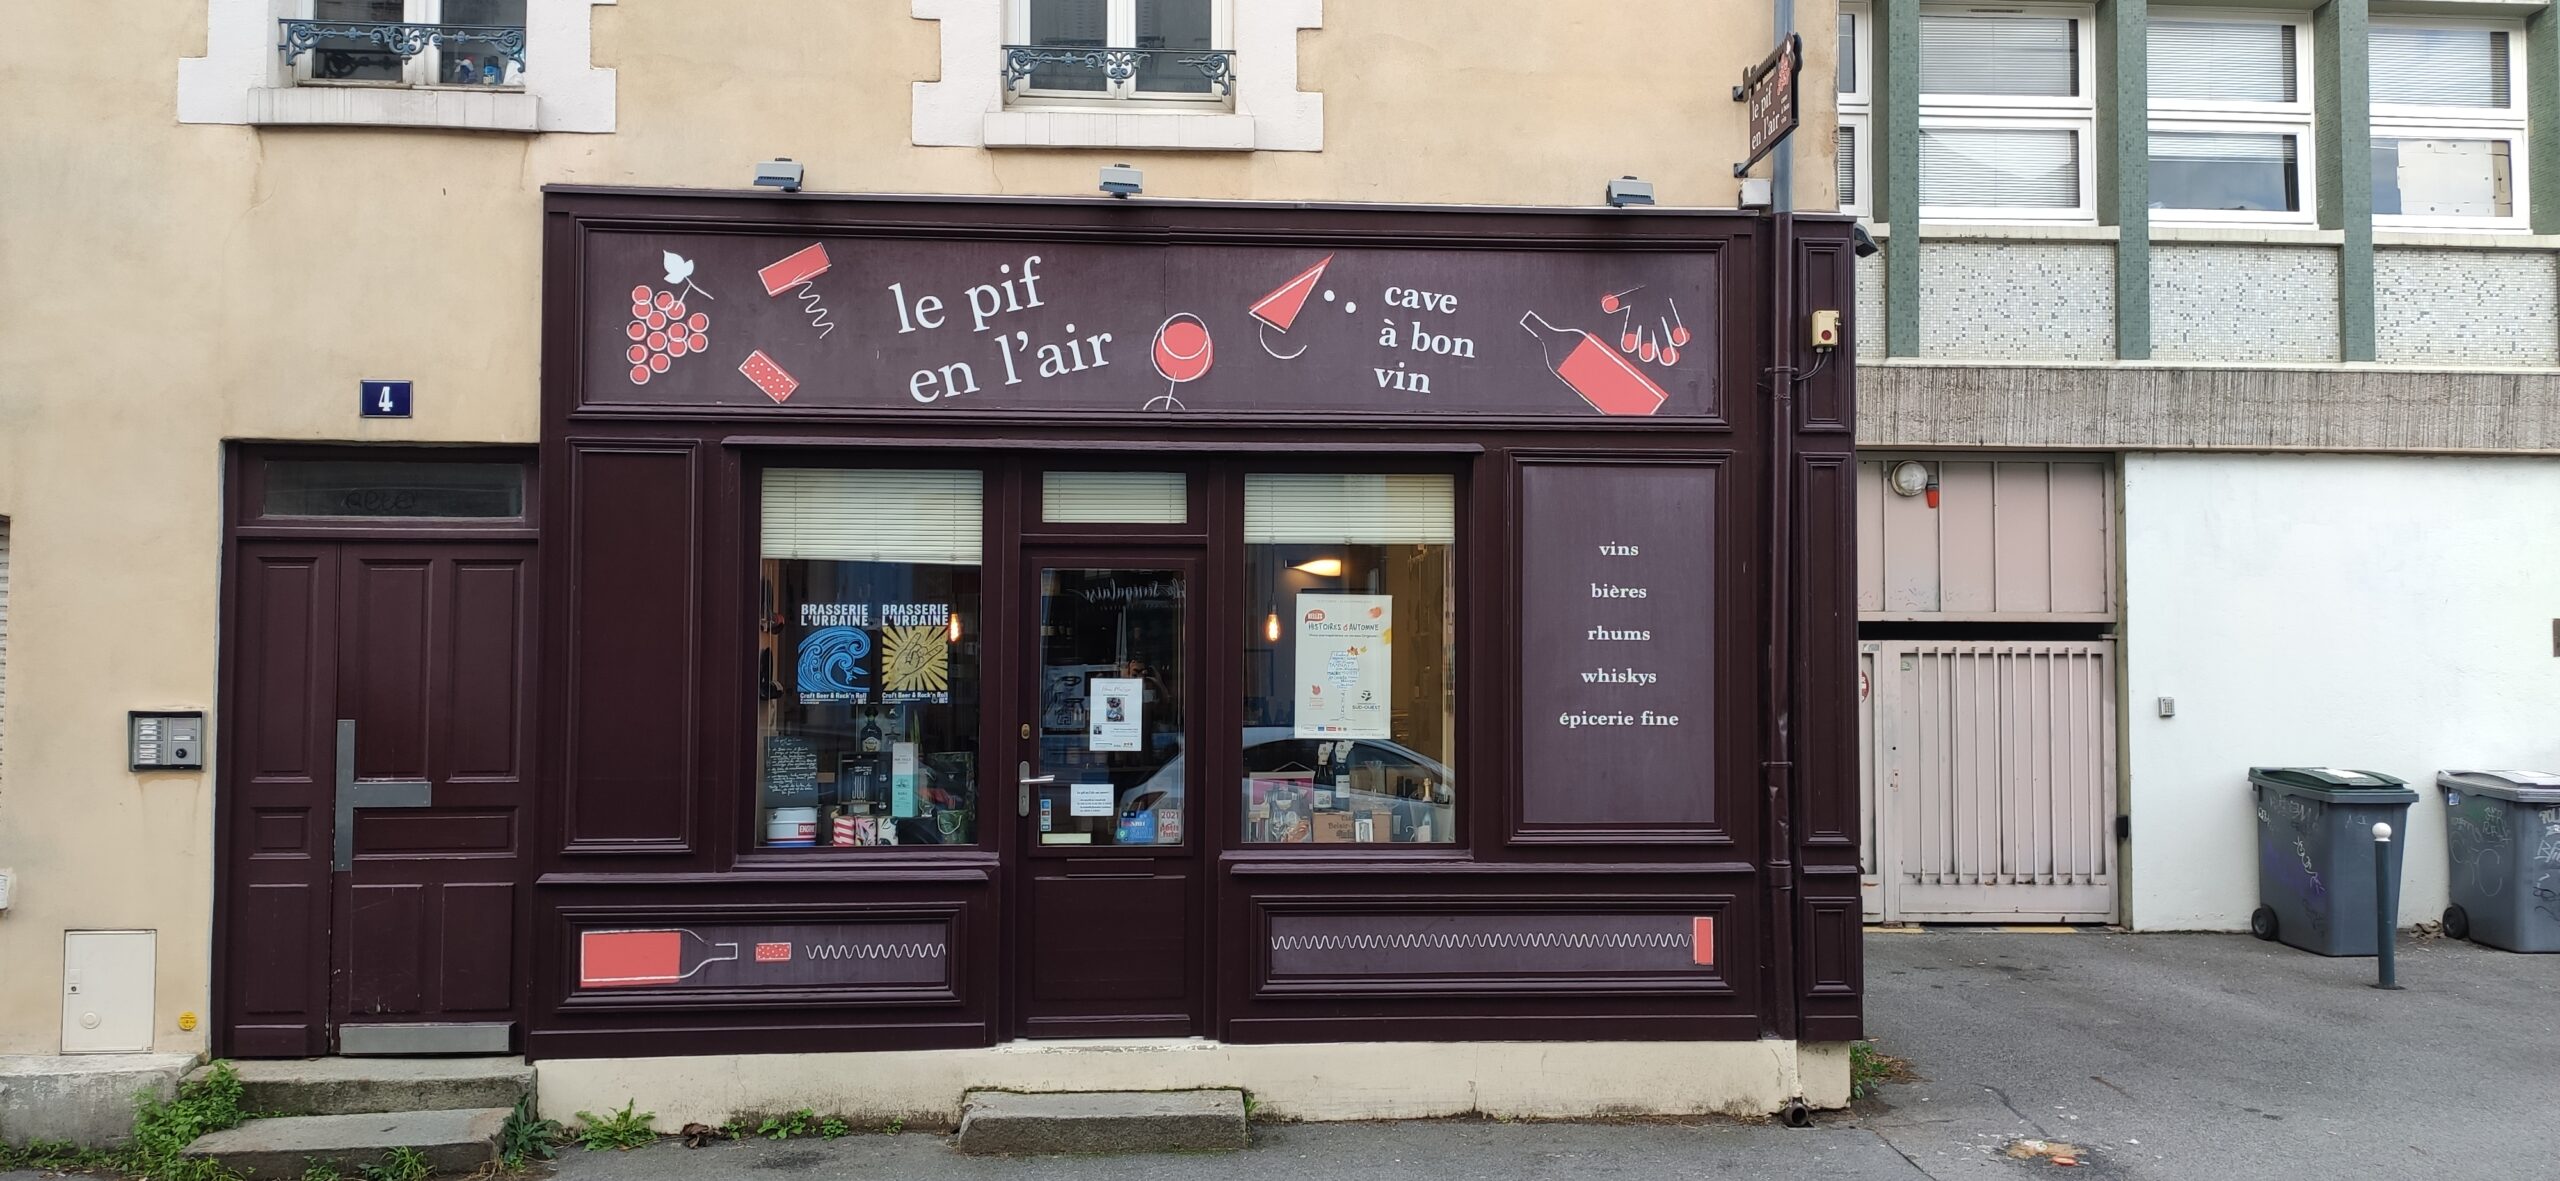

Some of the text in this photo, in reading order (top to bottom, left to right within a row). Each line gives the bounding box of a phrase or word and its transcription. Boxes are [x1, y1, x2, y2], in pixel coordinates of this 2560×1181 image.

[1751, 82, 1772, 122] le pif
[1751, 130, 1762, 150] en
[887, 256, 1046, 335] le pif
[1383, 285, 1459, 315] cave
[1378, 318, 1476, 358] à bon
[908, 361, 981, 404] en
[1373, 361, 1431, 395] vin
[378, 386, 394, 411] 4
[1598, 541, 1640, 556] vins
[1590, 582, 1648, 599] bières
[801, 603, 869, 616] BRASSERIE
[882, 603, 949, 616] BRASSERIE
[801, 615, 869, 627] L'URBAINE
[882, 615, 949, 626] L'URBAINE
[1308, 623, 1341, 631] HISTOIRES
[1587, 625, 1651, 641] rhums
[1580, 667, 1658, 687] whiskys
[1558, 710, 1680, 729] épicerie fine
[1161, 811, 1179, 819] 2021
